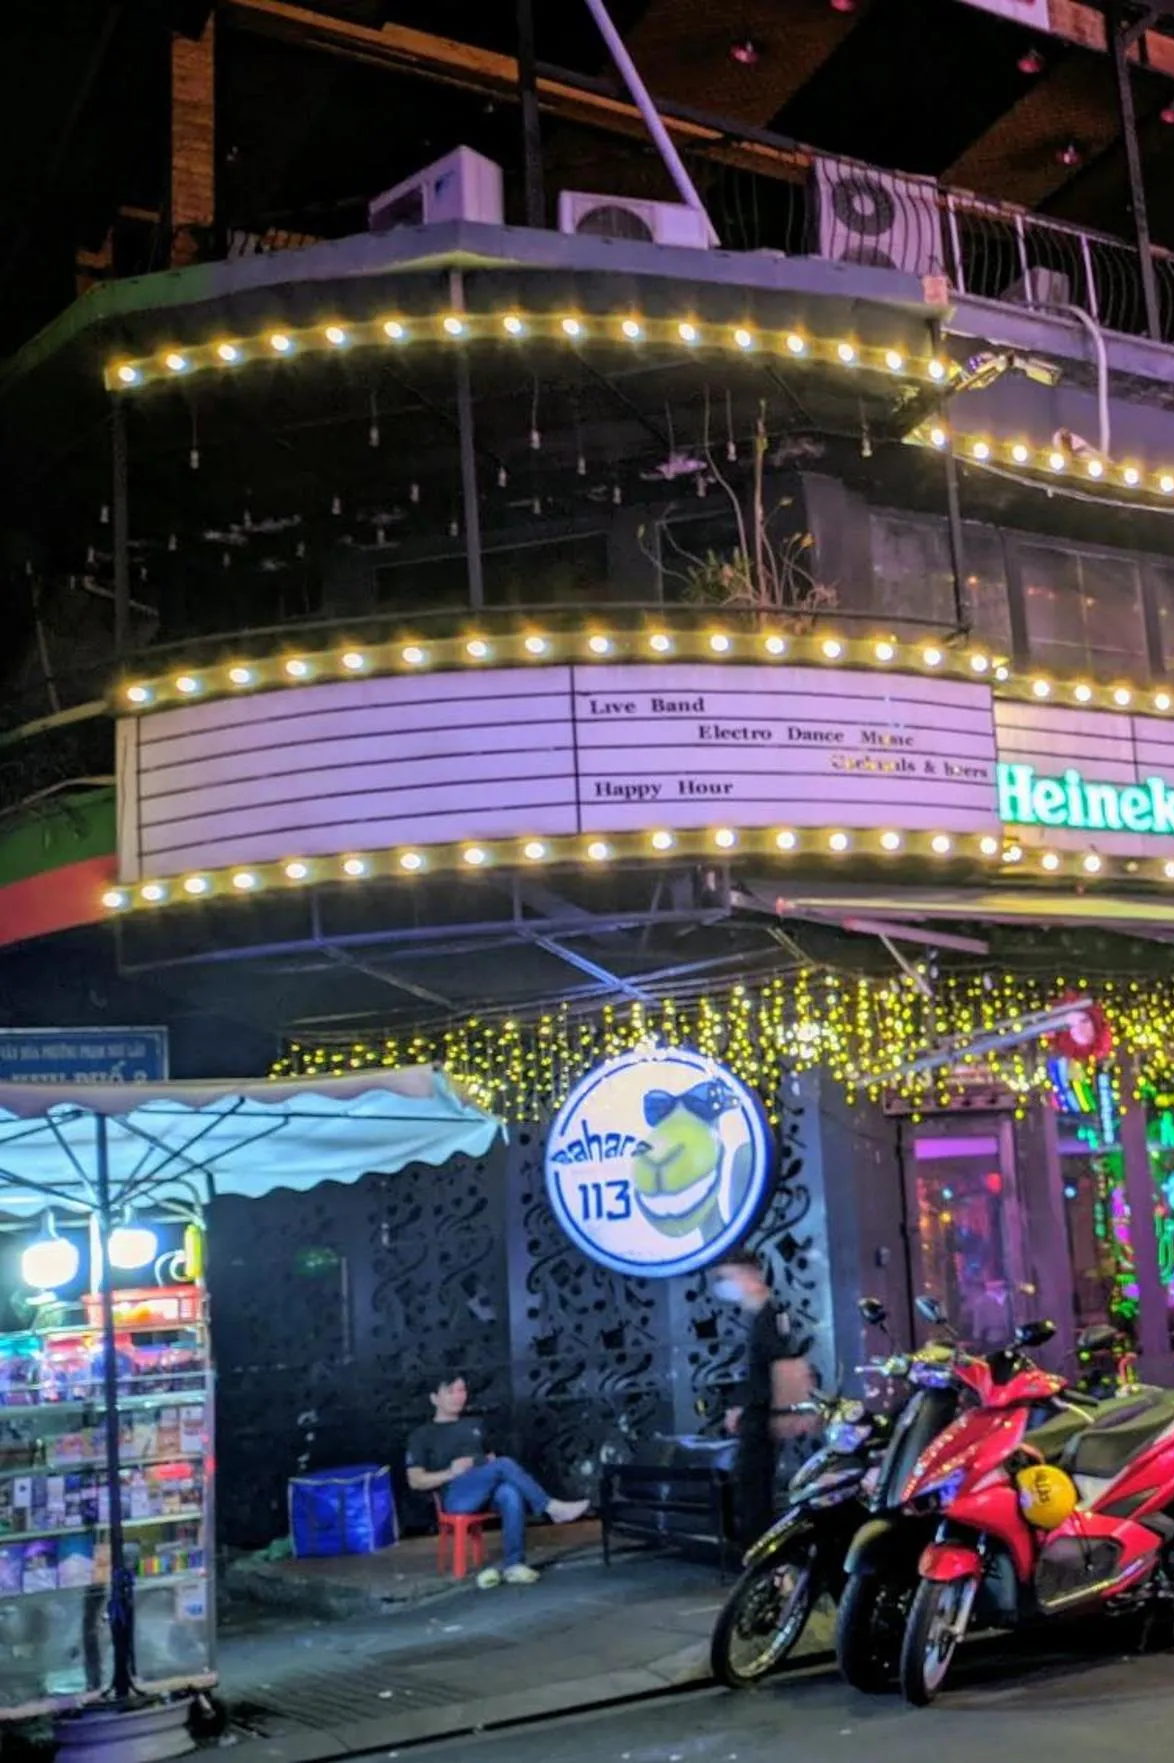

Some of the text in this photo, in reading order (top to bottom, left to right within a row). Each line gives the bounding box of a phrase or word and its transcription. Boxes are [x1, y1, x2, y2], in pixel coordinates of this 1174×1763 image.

[590, 697, 705, 715] Live Band
[699, 724, 772, 741] Electro
[787, 726, 844, 744] Dance
[594, 780, 733, 799] Happy Hour
[578, 1179, 631, 1221] 113
